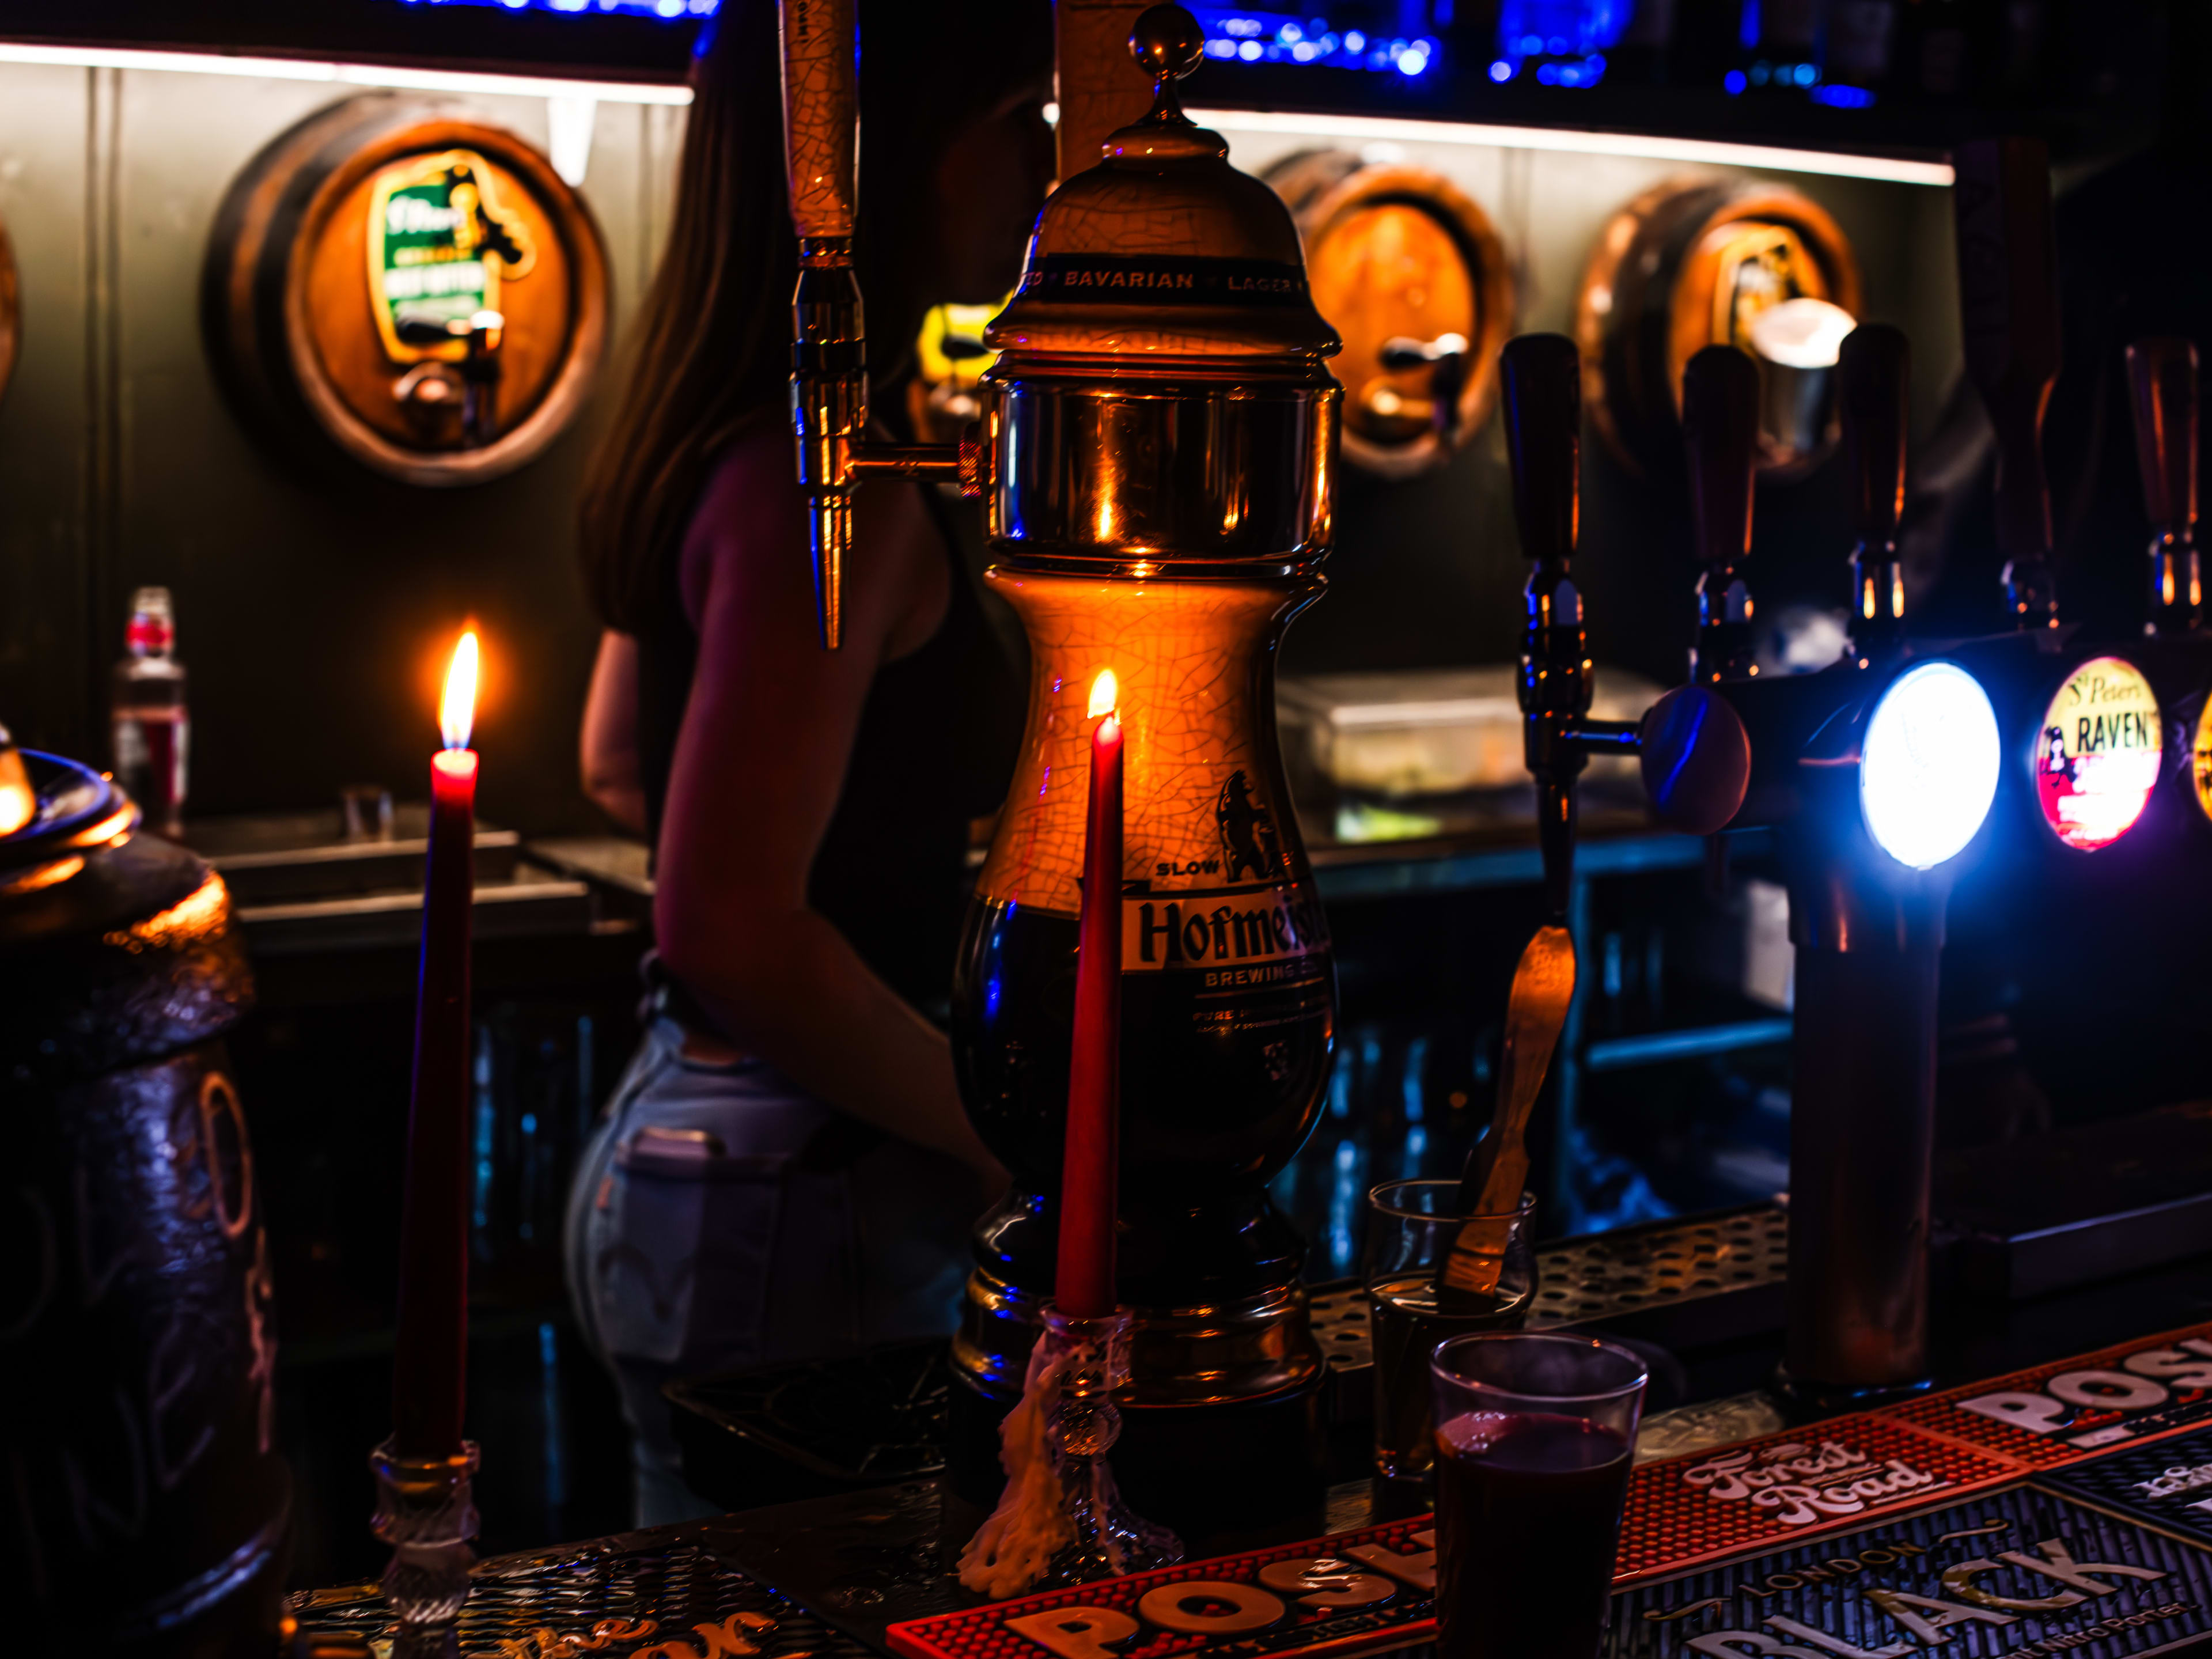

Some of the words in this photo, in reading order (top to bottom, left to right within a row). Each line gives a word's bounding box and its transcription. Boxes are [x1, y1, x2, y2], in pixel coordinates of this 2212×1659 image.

[1063, 270, 1194, 289] BAVARIAN
[1228, 275, 1290, 293] LAGER
[2077, 711, 2148, 753] RAVEN
[1156, 859, 1220, 876] SLOW
[1205, 964, 1295, 988] BREWING
[1955, 1338, 2212, 1435] POS
[1682, 1440, 1867, 1499] Forest
[1751, 1459, 1934, 1525] Road
[1738, 1539, 1927, 1600] LONDON
[1683, 1537, 2171, 1659] BLACK
[2032, 1627, 2111, 1653] Nitro
